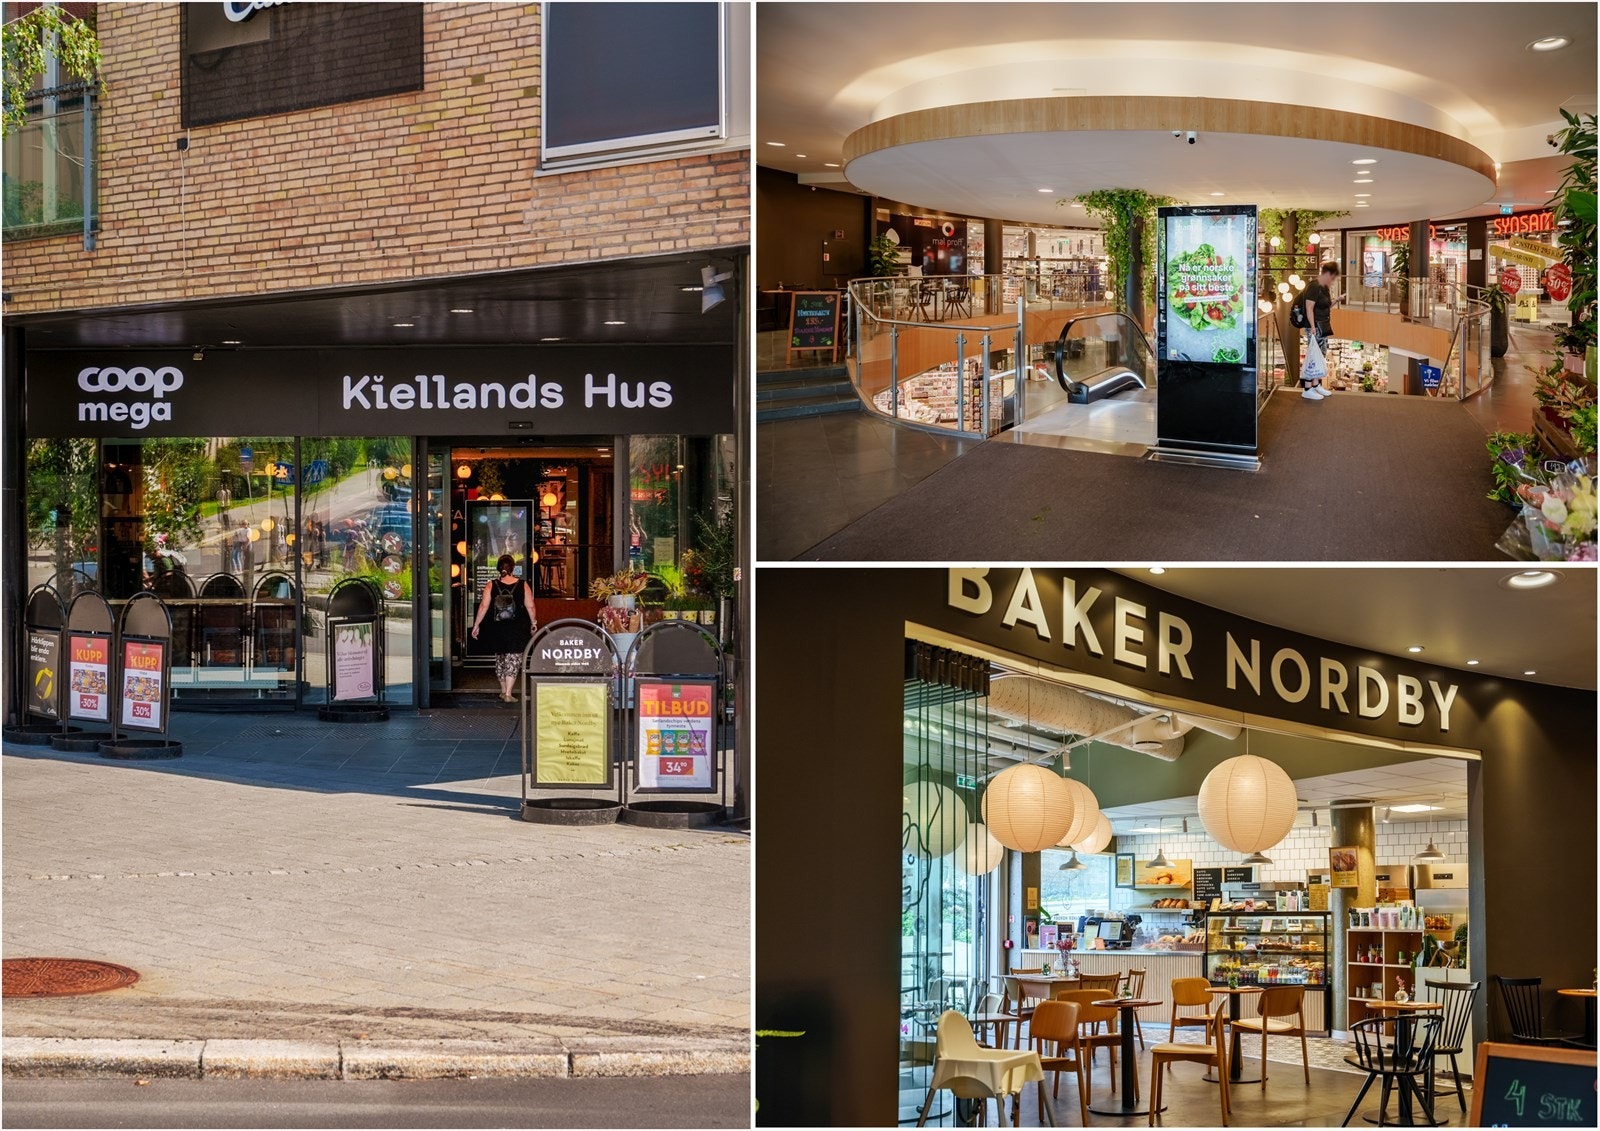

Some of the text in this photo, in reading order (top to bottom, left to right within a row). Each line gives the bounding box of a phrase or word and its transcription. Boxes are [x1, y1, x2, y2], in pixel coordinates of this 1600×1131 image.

[1179, 263, 1234, 273] Nå er norske
[1181, 274, 1232, 283] grønnsaker
[1547, 277, 1568, 294] 50%
[1179, 283, 1234, 293] på sitt beste
[77, 366, 184, 398] coop
[343, 373, 673, 410] Kiellands Hus
[78, 402, 172, 430] mega
[76, 649, 103, 662] KUPP
[542, 648, 602, 660] NORDBY
[947, 567, 1459, 731] BAKER NORDBY
[131, 655, 157, 669] KUPP
[80, 699, 98, 709] -30%
[133, 705, 150, 717] -30%
[643, 700, 710, 715] TILBUD
[1504, 1079, 1583, 1121] 4 STK
